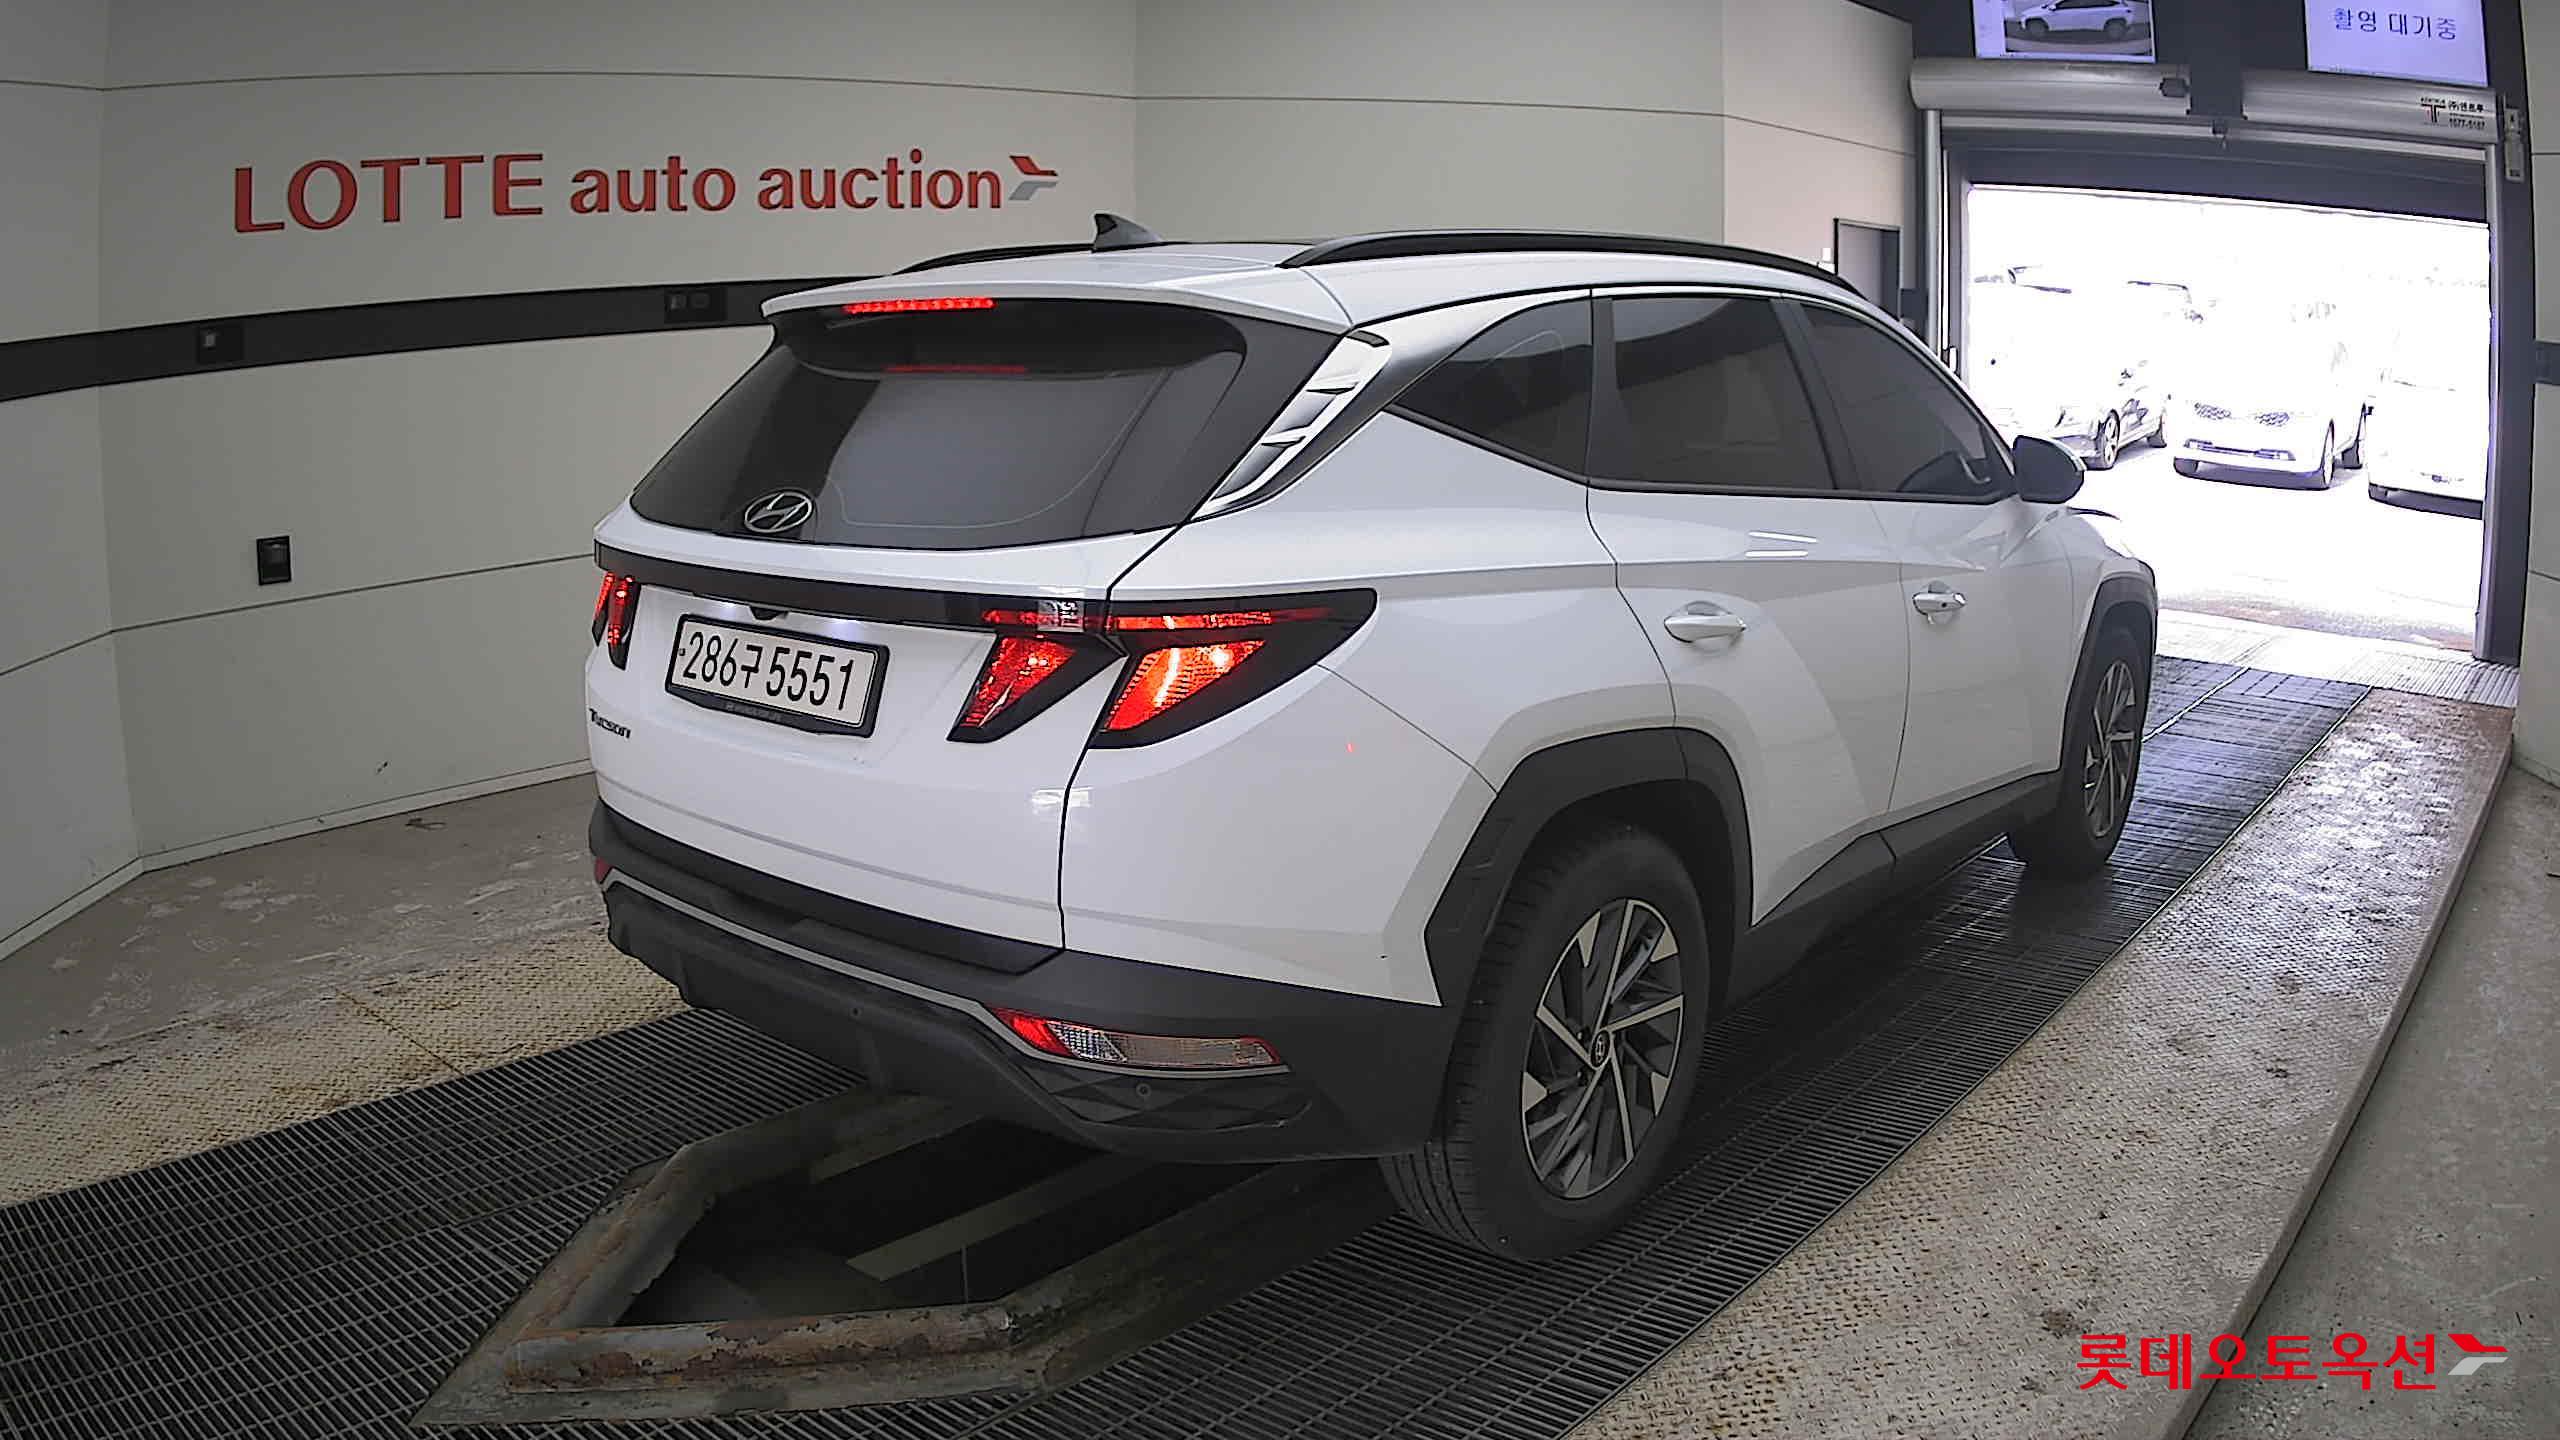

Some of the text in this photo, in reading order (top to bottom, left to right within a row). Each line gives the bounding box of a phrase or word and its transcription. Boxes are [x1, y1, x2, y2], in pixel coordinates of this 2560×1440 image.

[2334, 8, 2456, 40] 촬영 대기중
[235, 148, 1004, 233] LOTTE auto auction
